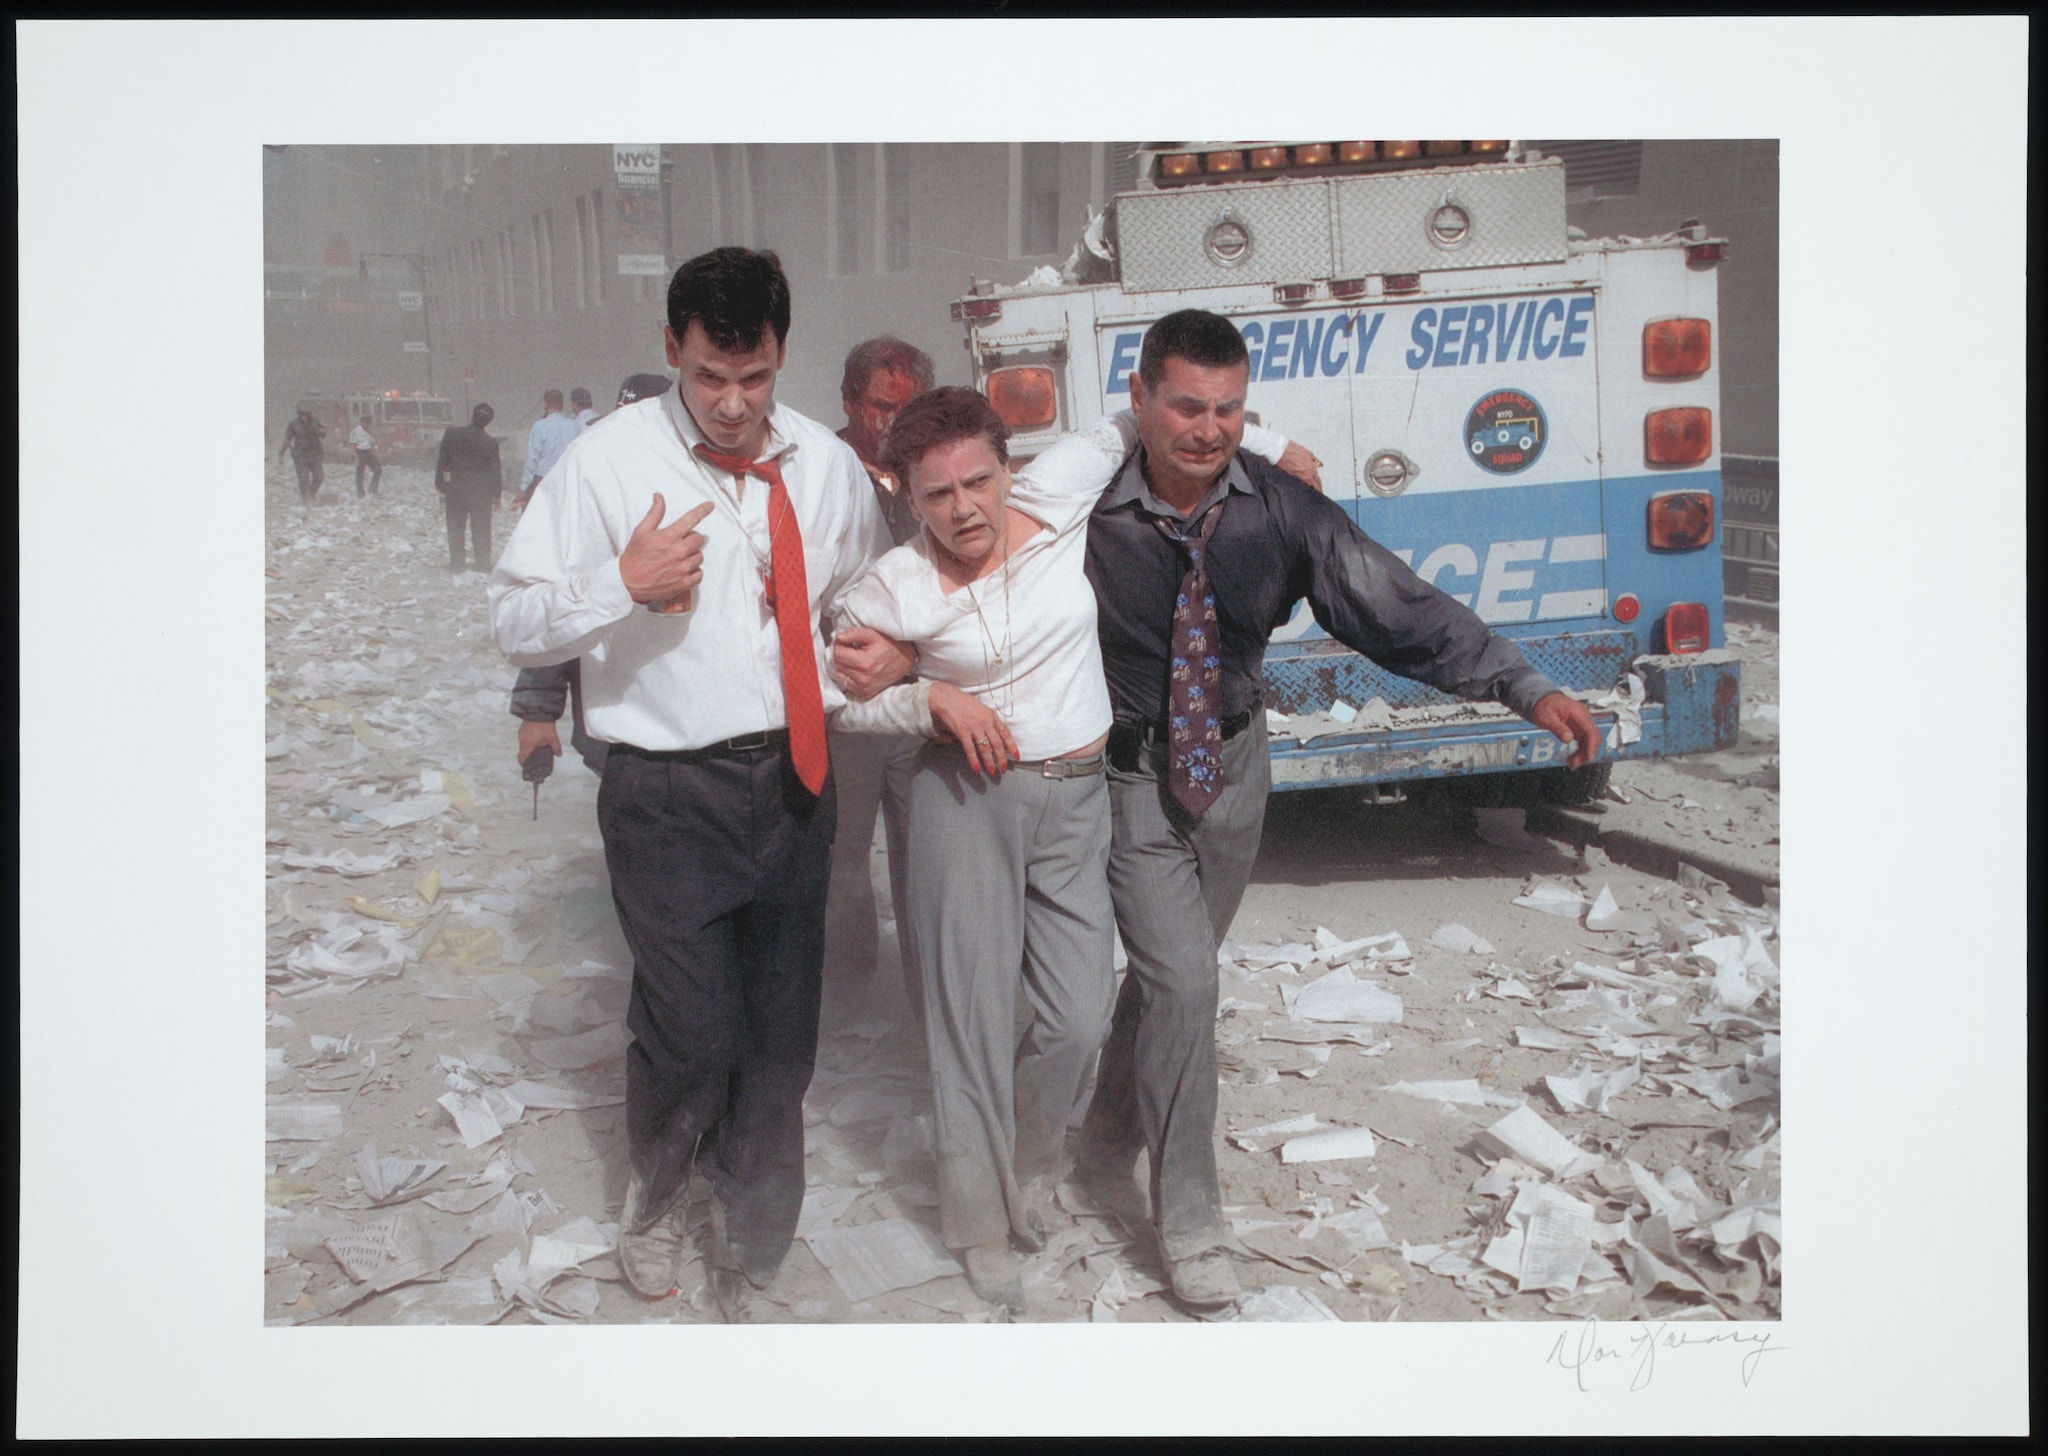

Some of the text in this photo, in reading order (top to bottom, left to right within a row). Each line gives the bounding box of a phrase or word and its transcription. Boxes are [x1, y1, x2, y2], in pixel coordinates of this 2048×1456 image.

[617, 150, 657, 168] NYC
[1105, 297, 1596, 395] EGENCY SERVICE
[1475, 392, 1535, 417] EMERGENCY
[1497, 410, 1513, 419] NYPD
[1492, 453, 1523, 464] SQUAD
